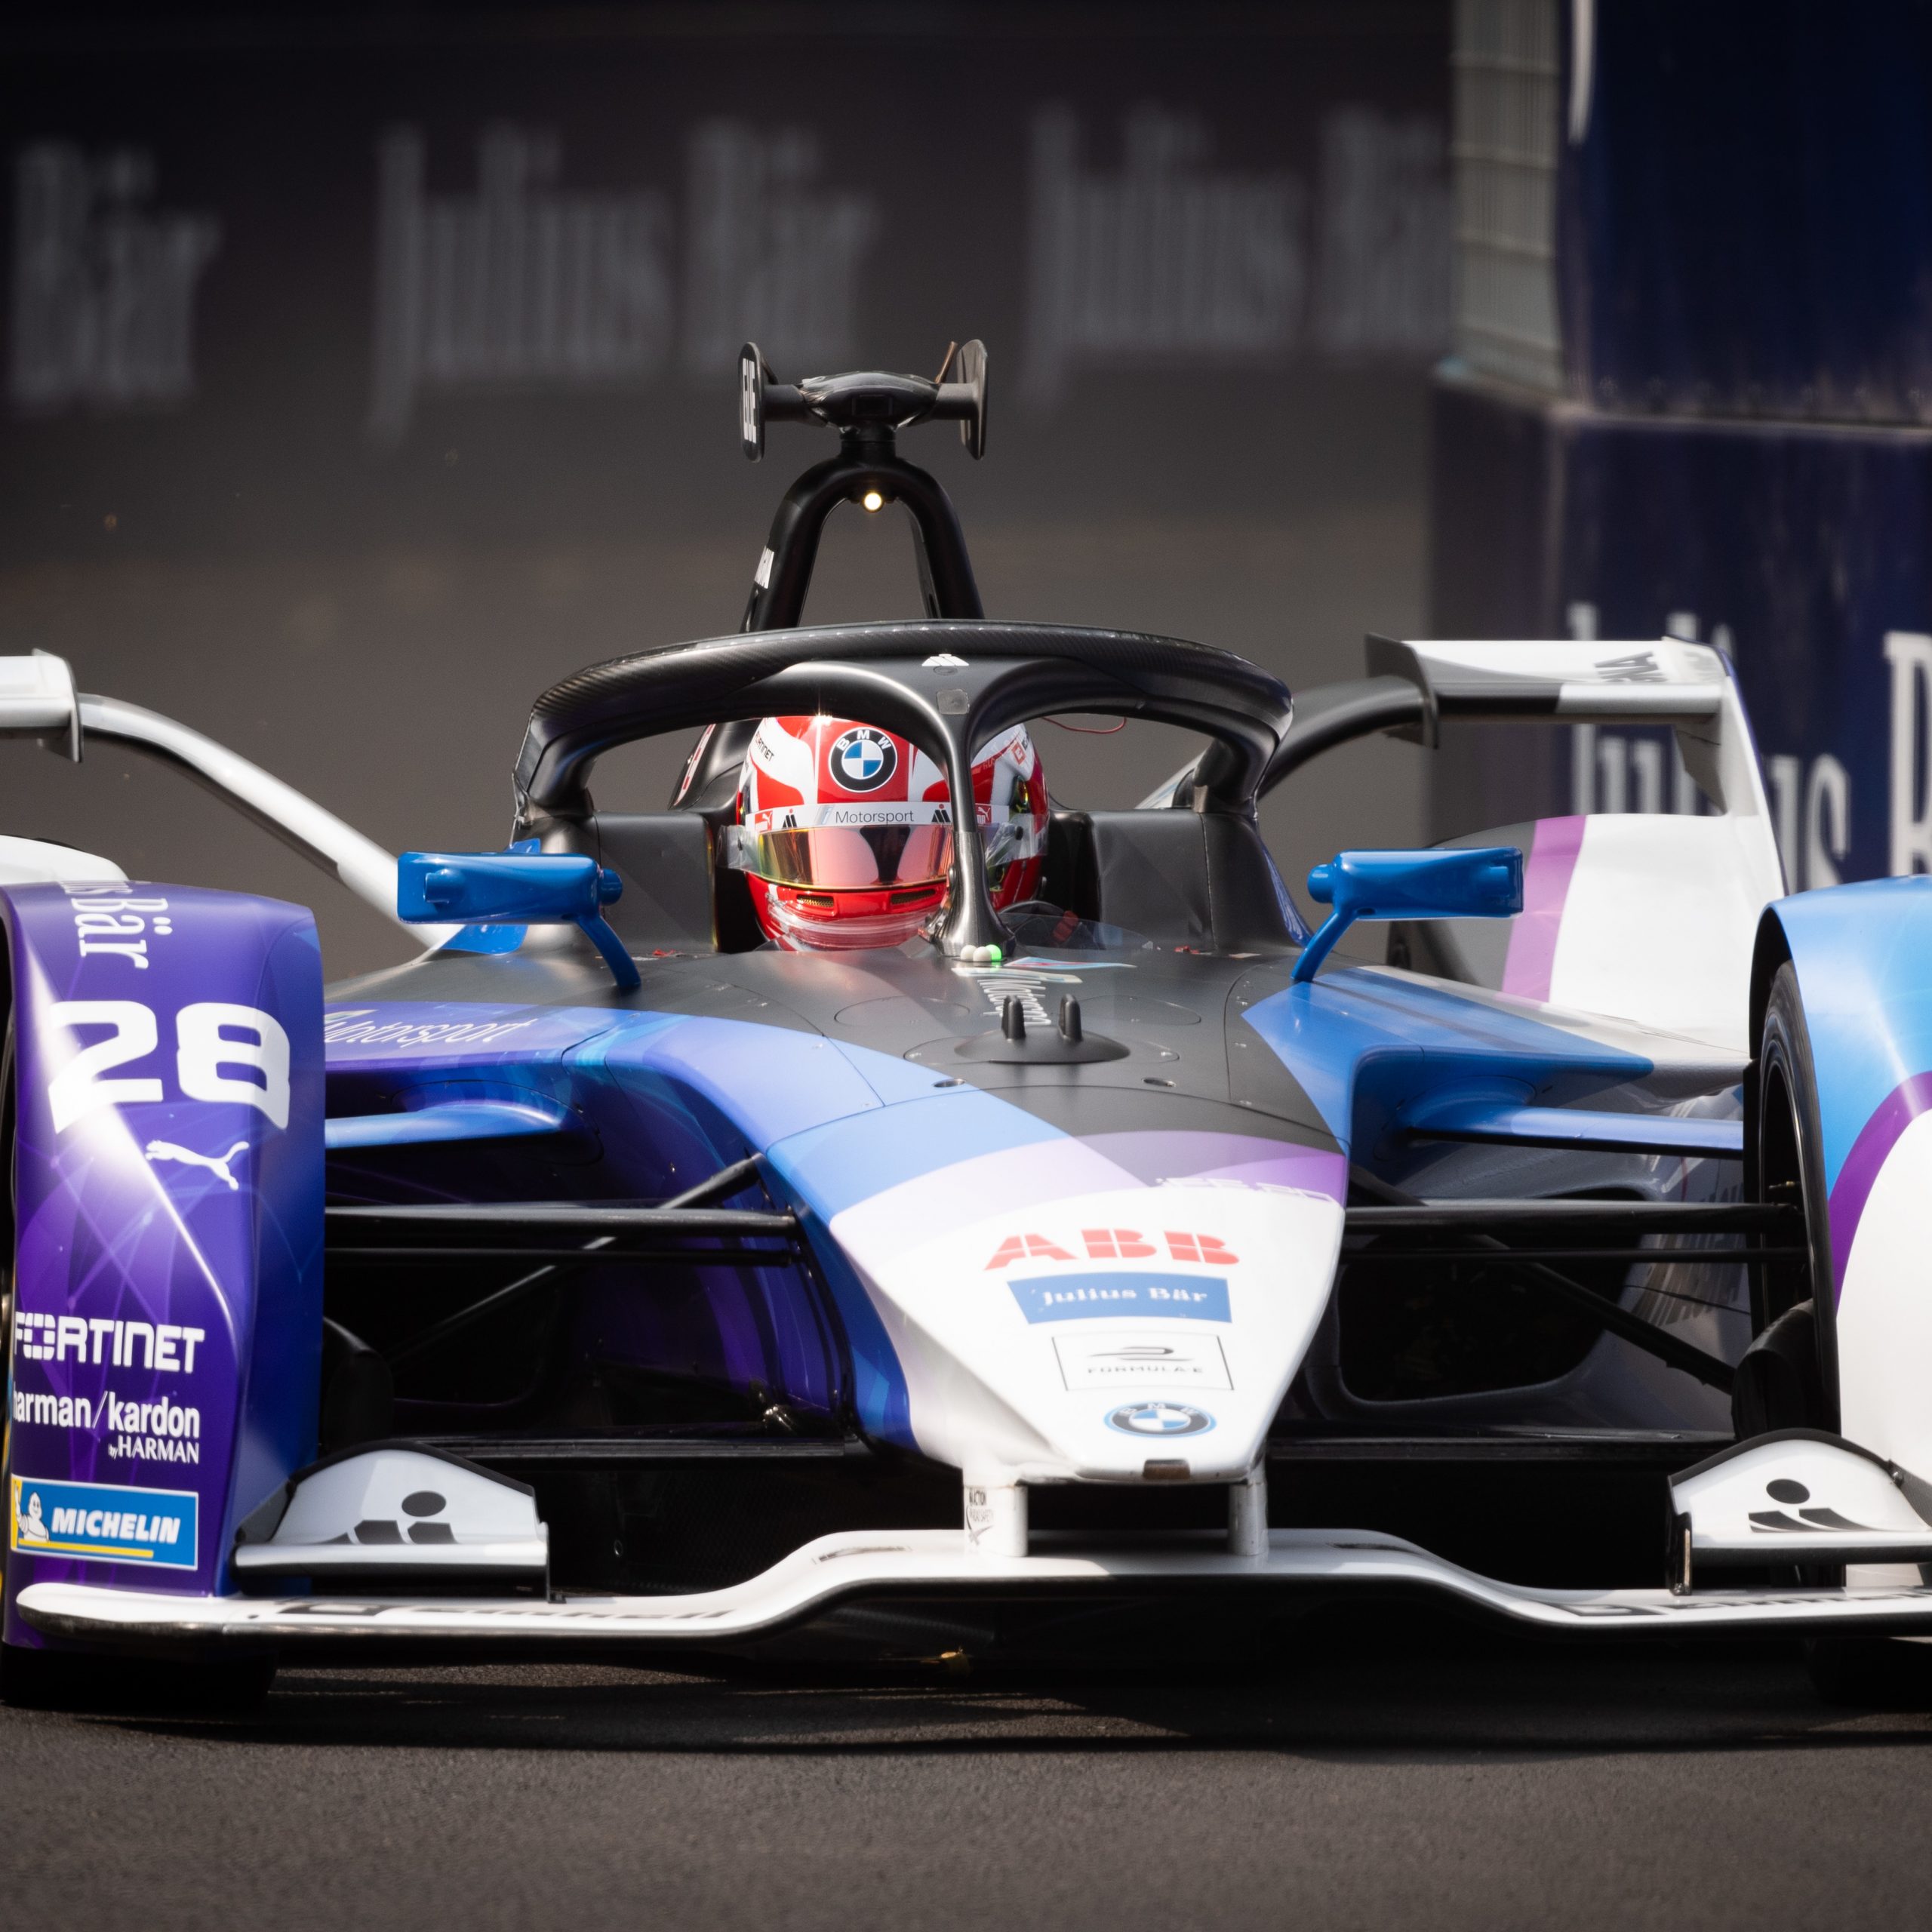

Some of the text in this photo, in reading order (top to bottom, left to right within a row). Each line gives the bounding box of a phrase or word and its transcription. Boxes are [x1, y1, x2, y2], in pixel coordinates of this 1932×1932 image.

[836, 729, 892, 752] BMW
[835, 810, 915, 826] Motorsport
[70, 897, 174, 970] Bär
[48, 1000, 291, 1134] 28
[983, 1229, 1241, 1272] ABB
[1042, 1287, 1137, 1307] Julius
[118, 1434, 200, 1465] HARMAN
[51, 1506, 181, 1545] MICHELIN
